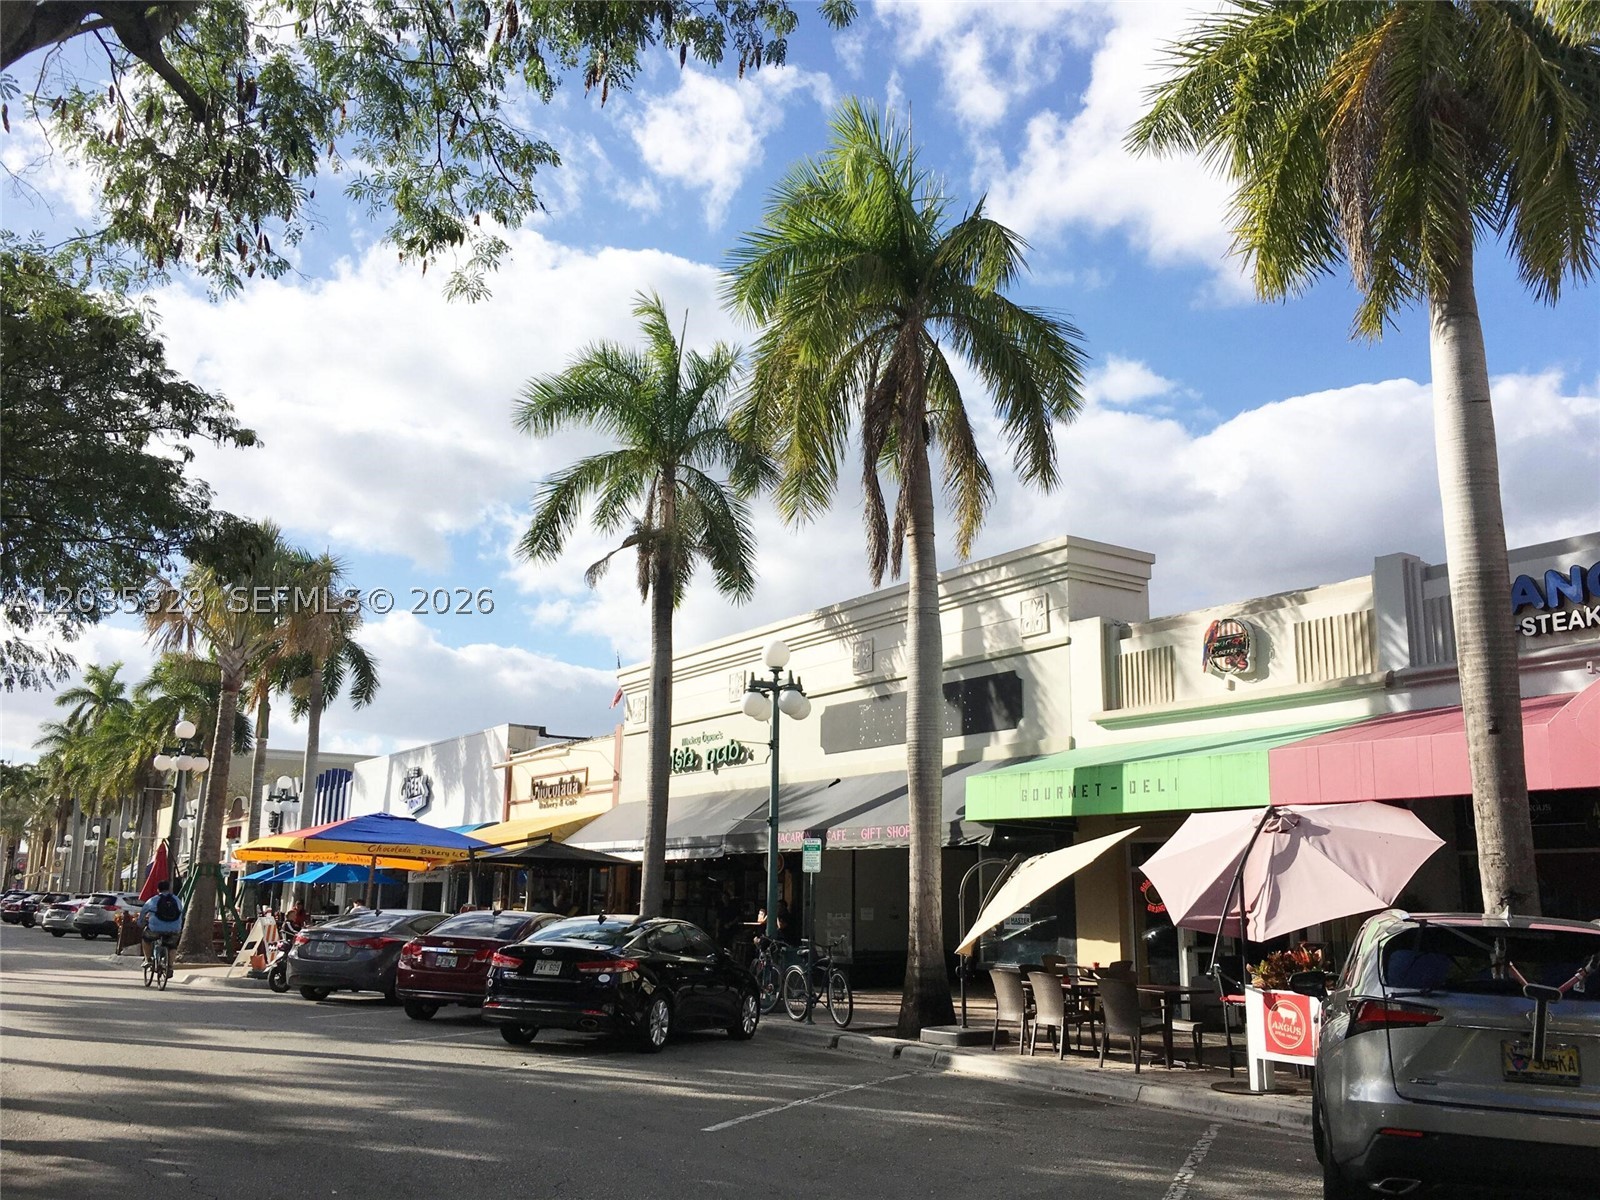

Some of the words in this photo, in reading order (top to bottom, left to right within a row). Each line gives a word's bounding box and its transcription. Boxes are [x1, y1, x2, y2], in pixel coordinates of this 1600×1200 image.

[671, 746, 696, 769] ish
[706, 739, 740, 771] pub
[1021, 783, 1102, 801] GOURMET
[1129, 777, 1178, 795] DELI
[861, 827, 882, 839] GIFT
[420, 848, 450, 857] Bakery
[1272, 1020, 1302, 1036] ANGUS
